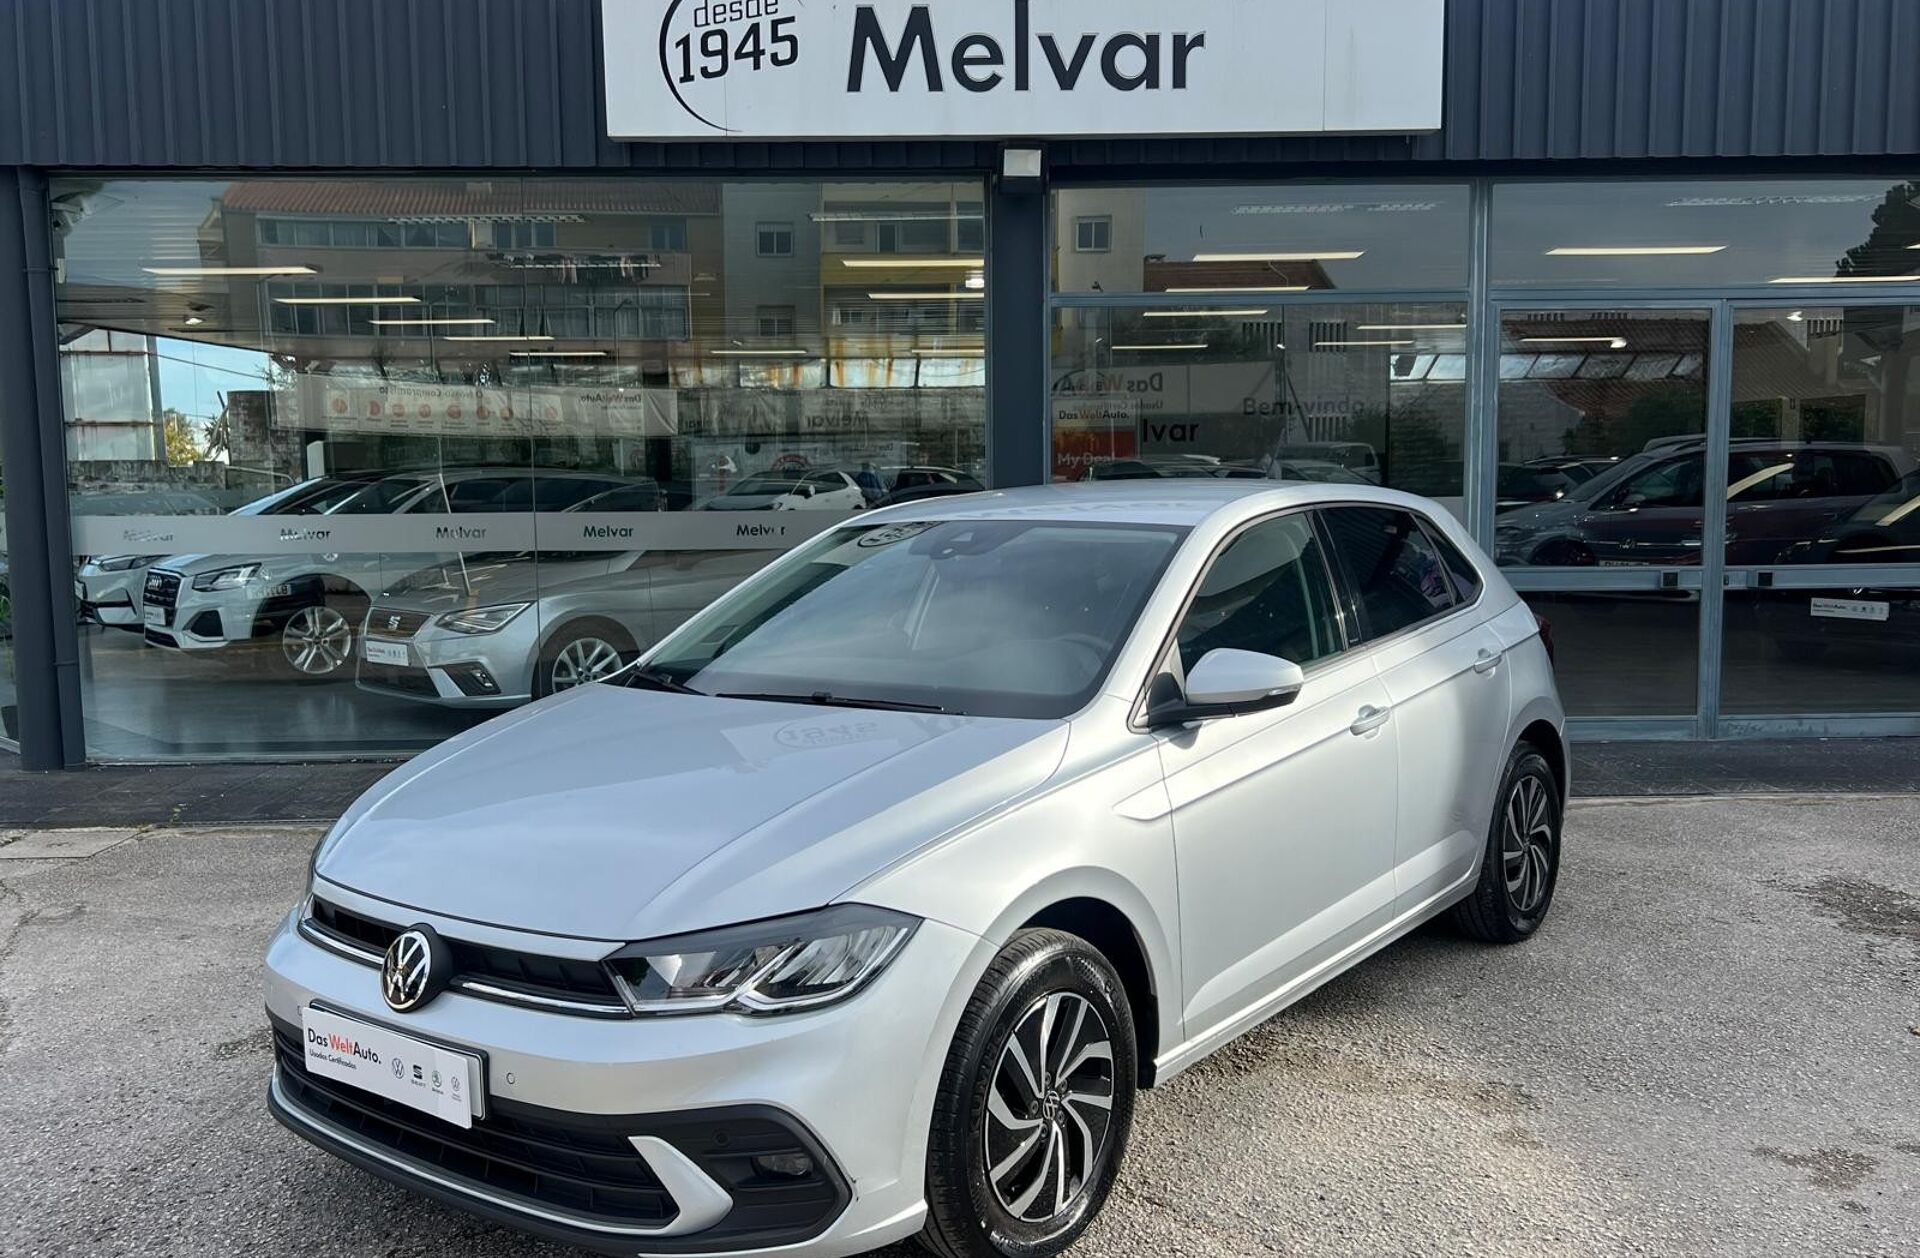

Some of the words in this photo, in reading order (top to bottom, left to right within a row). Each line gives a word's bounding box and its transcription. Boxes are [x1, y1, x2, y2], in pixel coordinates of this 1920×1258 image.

[694, 0, 779, 28] desde
[674, 15, 799, 84] 1945
[846, 0, 1207, 93] Melvar
[1142, 417, 1200, 443] lvar
[1057, 452, 1079, 468] My
[583, 524, 635, 538] Melvar
[736, 524, 786, 537] Melvr
